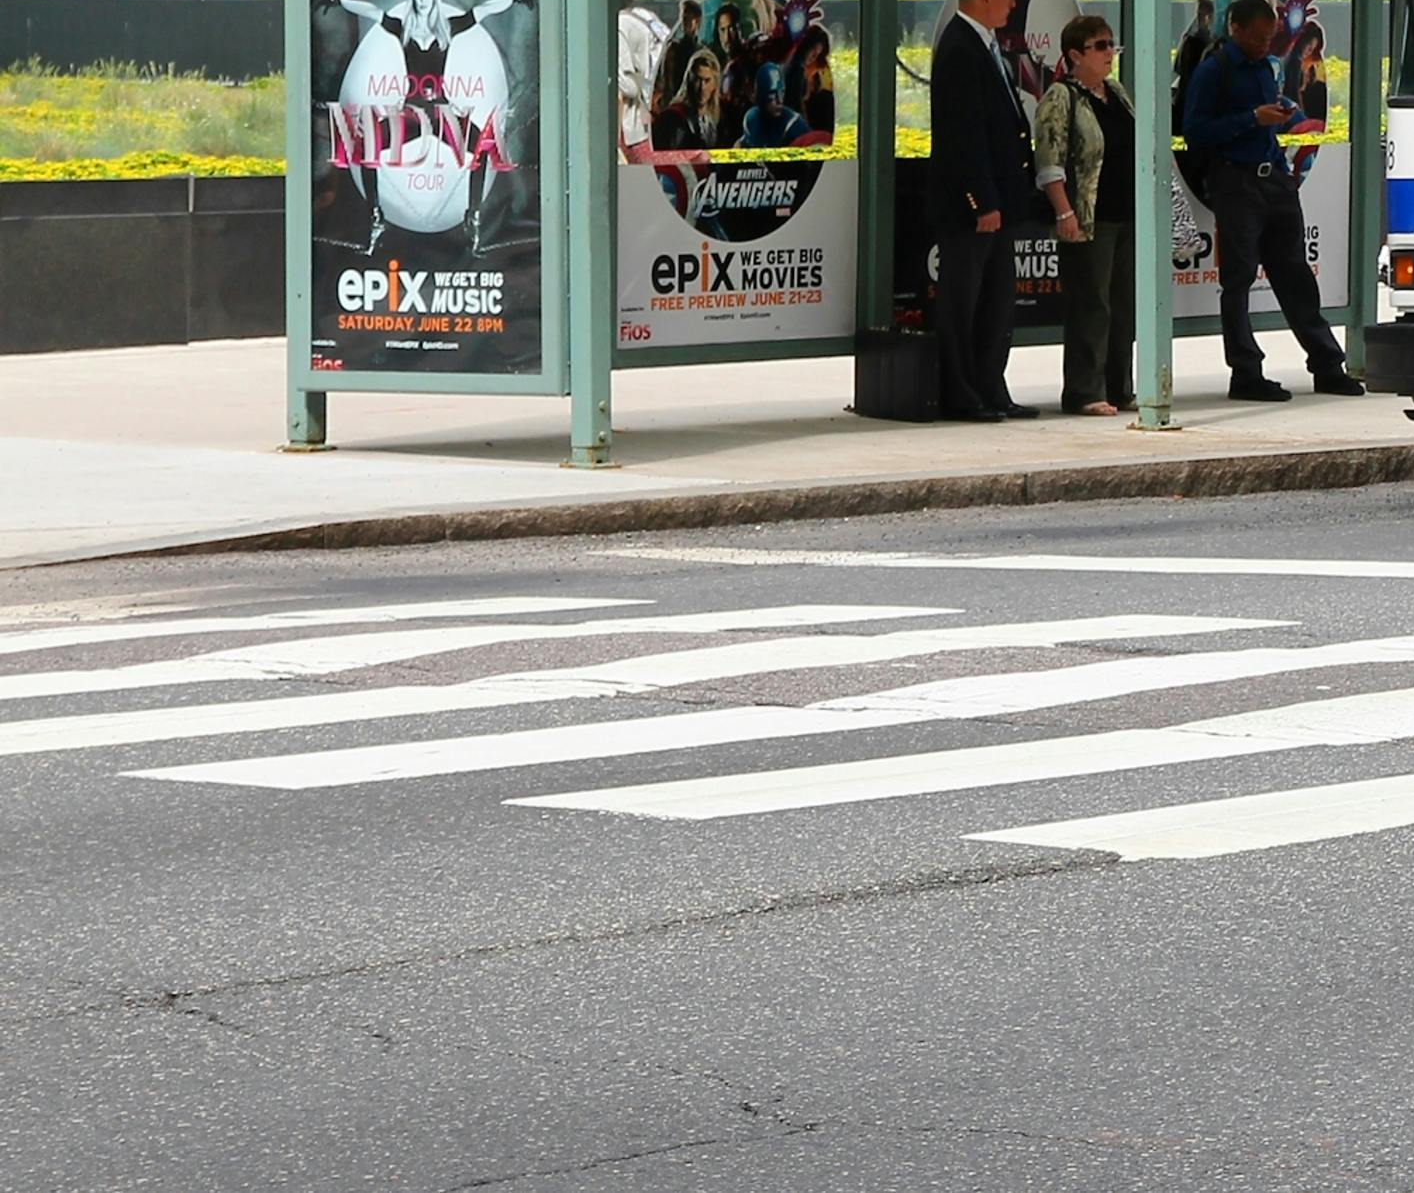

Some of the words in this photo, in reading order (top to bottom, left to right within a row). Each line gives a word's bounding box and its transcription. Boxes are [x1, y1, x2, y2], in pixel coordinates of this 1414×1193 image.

[367, 74, 485, 99] MADONNA
[326, 101, 519, 172] MDNA
[407, 173, 445, 190] TOUR
[692, 172, 799, 217] AVENGERS
[1014, 240, 1032, 253] WE
[1035, 239, 1058, 253] GET
[740, 251, 761, 266] WE
[767, 249, 795, 265] GET
[800, 248, 823, 263] BIG
[1013, 255, 1059, 279] MUS
[434, 272, 450, 286] WE
[452, 272, 478, 286] GET
[480, 272, 504, 287] BIG
[742, 266, 822, 291] MOVIES
[1172, 271, 1199, 285] FREE
[432, 288, 503, 314] MUSIC
[651, 296, 684, 311] FREE
[689, 293, 746, 309] PREVIEW
[751, 291, 785, 306] JUNE
[789, 289, 822, 305] 21-23
[338, 315, 415, 333] SATURDAY,
[418, 318, 450, 332] JUNE
[454, 318, 472, 332] 22
[476, 318, 503, 332] 8PM
[620, 324, 651, 342] FiOS
